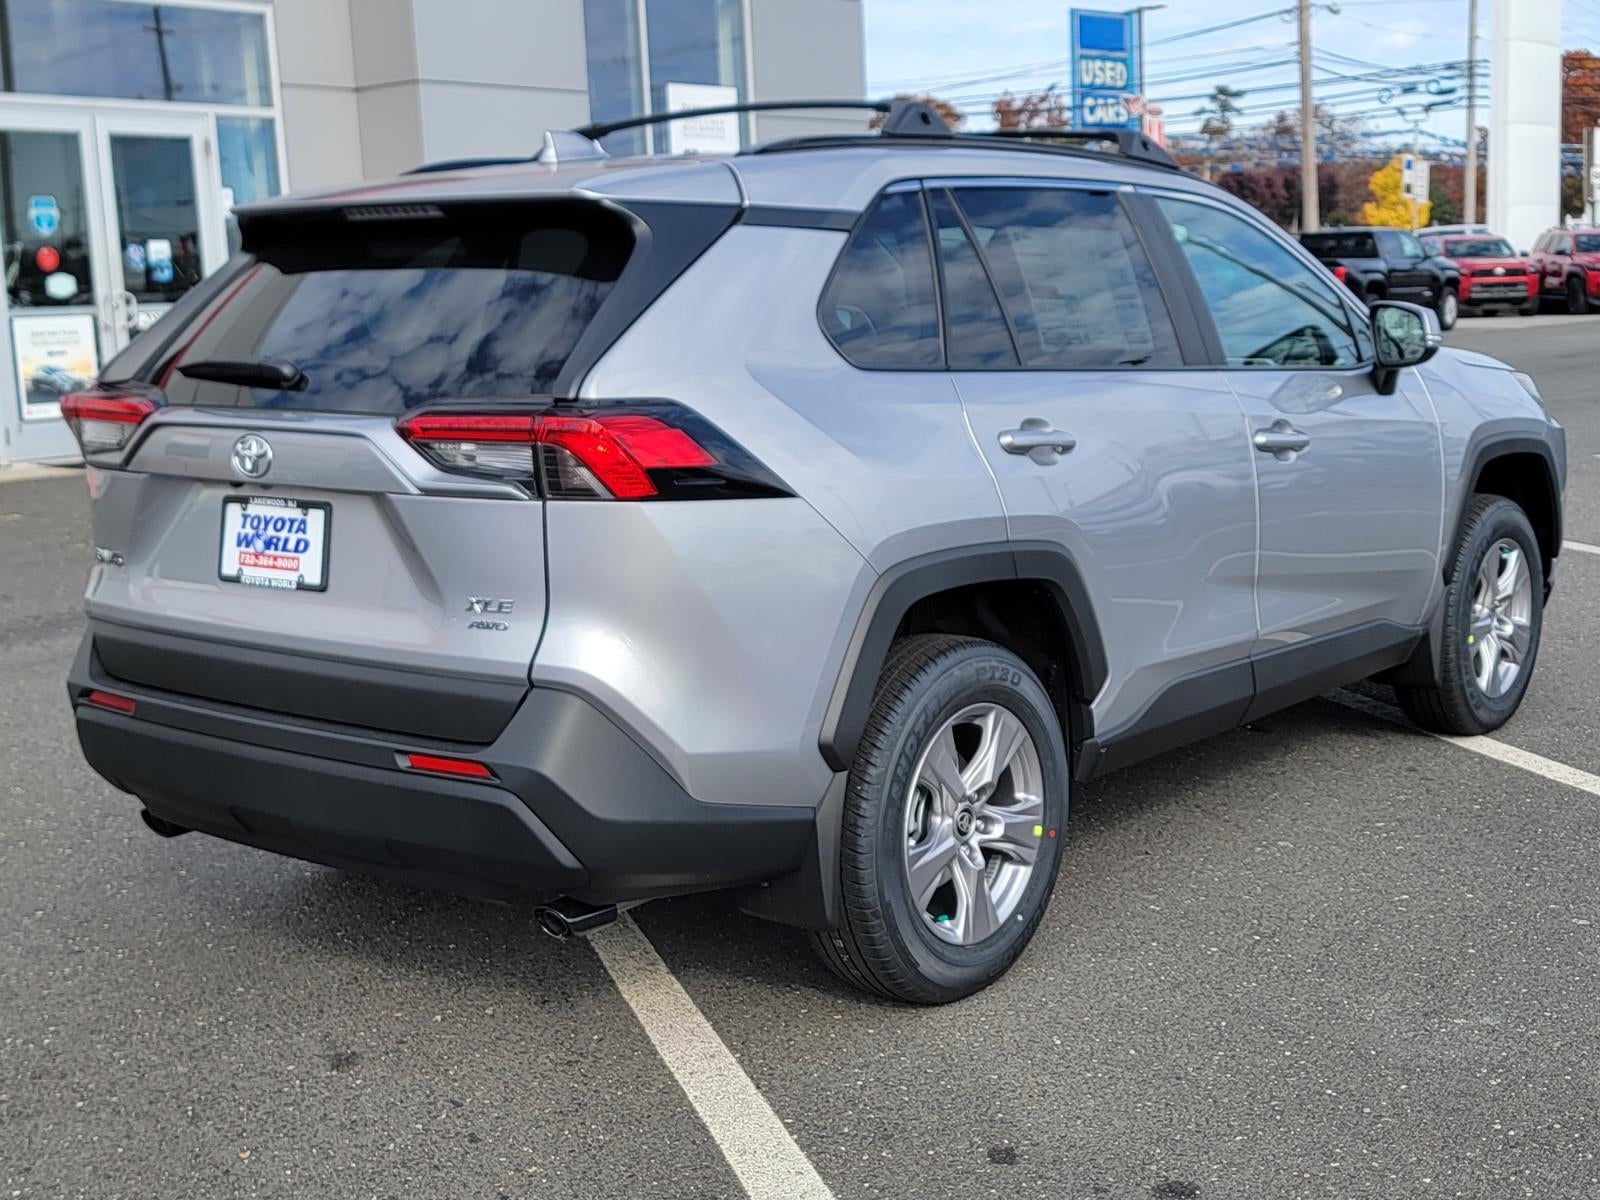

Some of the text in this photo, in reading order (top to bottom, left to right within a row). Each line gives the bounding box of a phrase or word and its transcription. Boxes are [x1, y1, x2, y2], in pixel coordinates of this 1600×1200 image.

[1080, 58, 1128, 88] USED
[1083, 96, 1129, 125] CARS
[241, 513, 307, 535] TOYOTA
[236, 531, 310, 554] WORLD
[242, 576, 297, 588] TOYOTA WORLD
[465, 597, 514, 614] XLE
[467, 620, 509, 631] AWD
